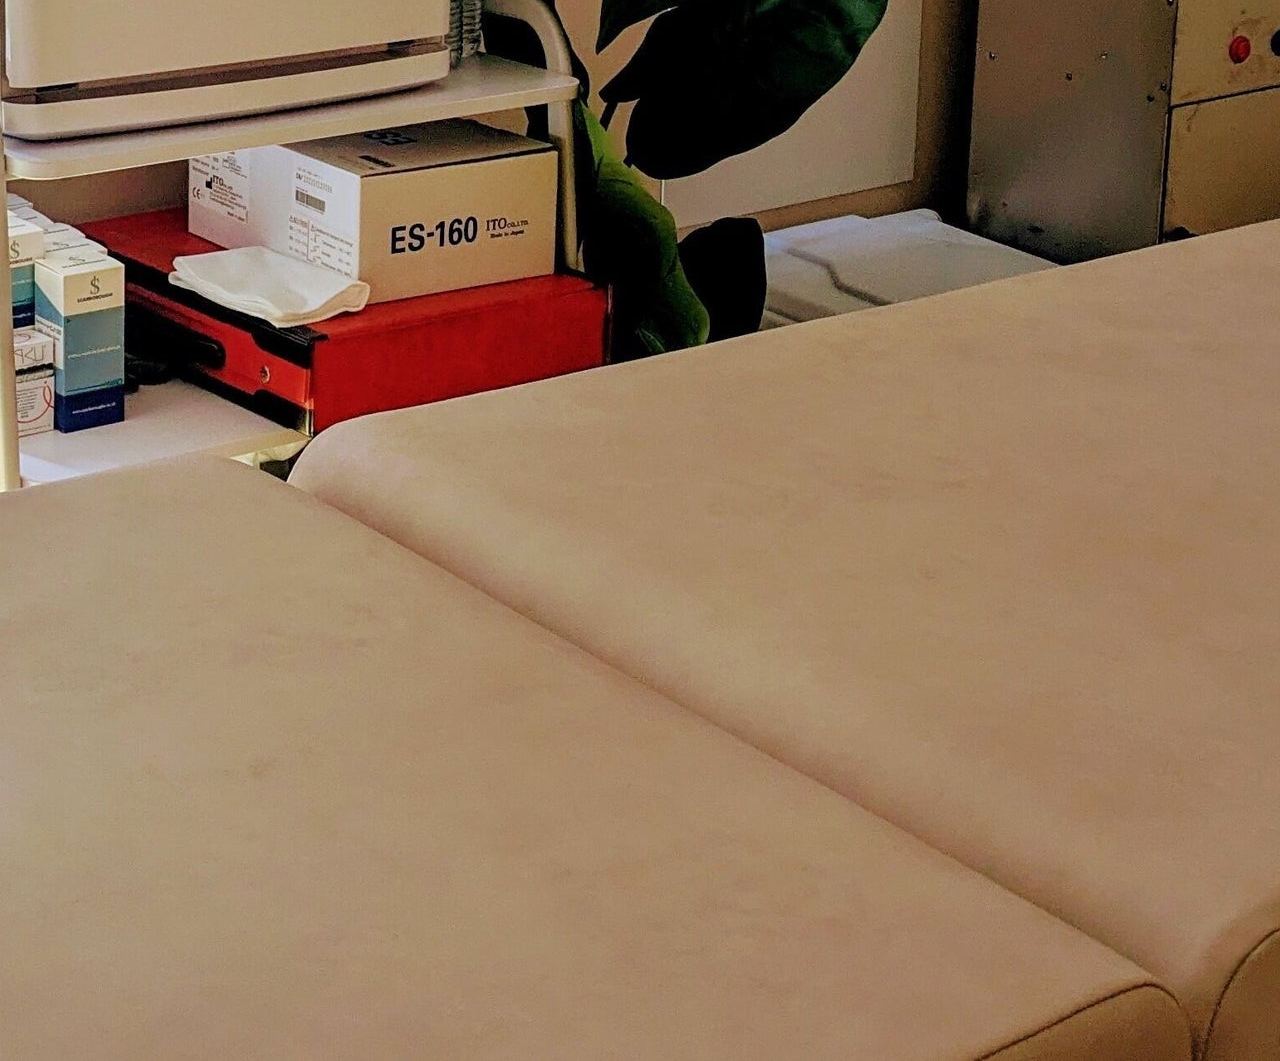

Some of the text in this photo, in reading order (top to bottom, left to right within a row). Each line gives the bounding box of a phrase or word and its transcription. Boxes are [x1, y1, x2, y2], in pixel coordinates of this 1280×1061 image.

[213, 174, 224, 186] ITO
[391, 215, 478, 255] ES-160
[486, 217, 507, 232] ITO
